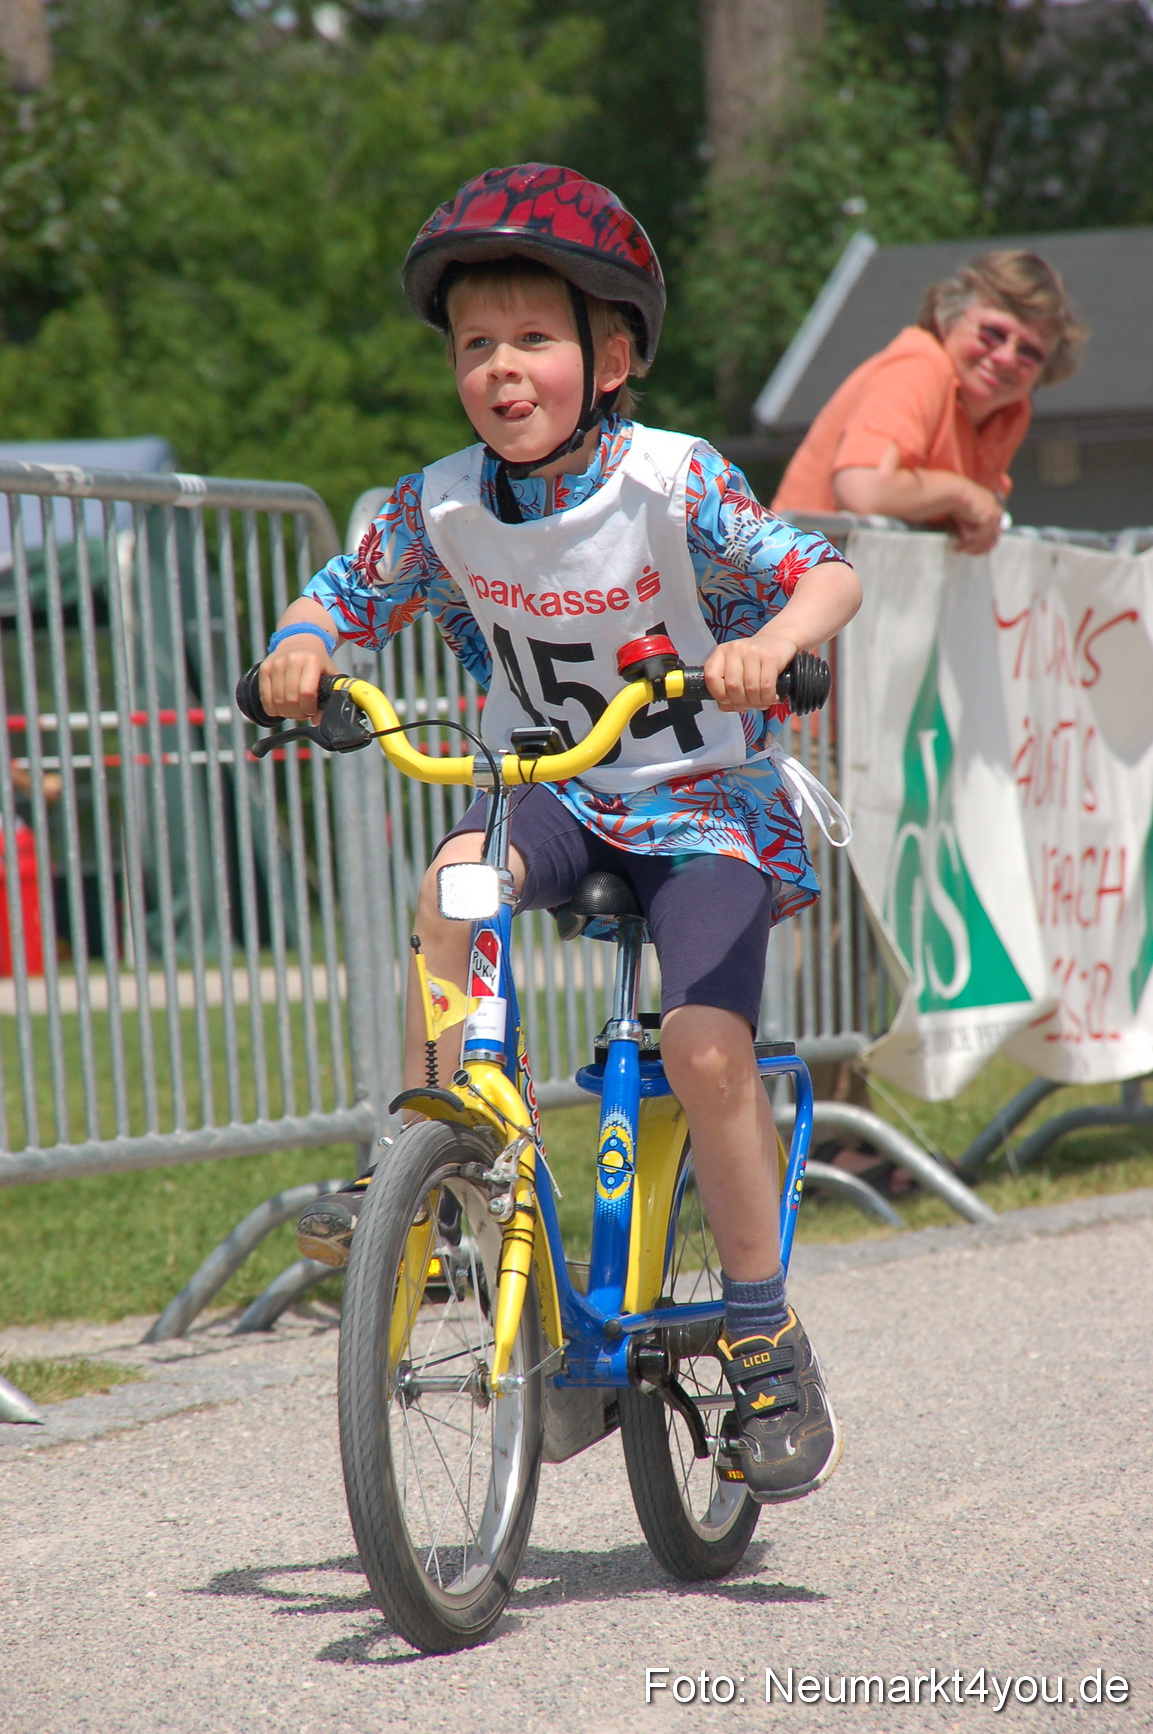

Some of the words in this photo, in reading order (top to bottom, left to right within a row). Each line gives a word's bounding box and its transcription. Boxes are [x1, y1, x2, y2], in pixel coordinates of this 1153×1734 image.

[464, 564, 630, 617] parkasse
[473, 951, 496, 987] PUKY
[743, 1352, 770, 1368] LICO
